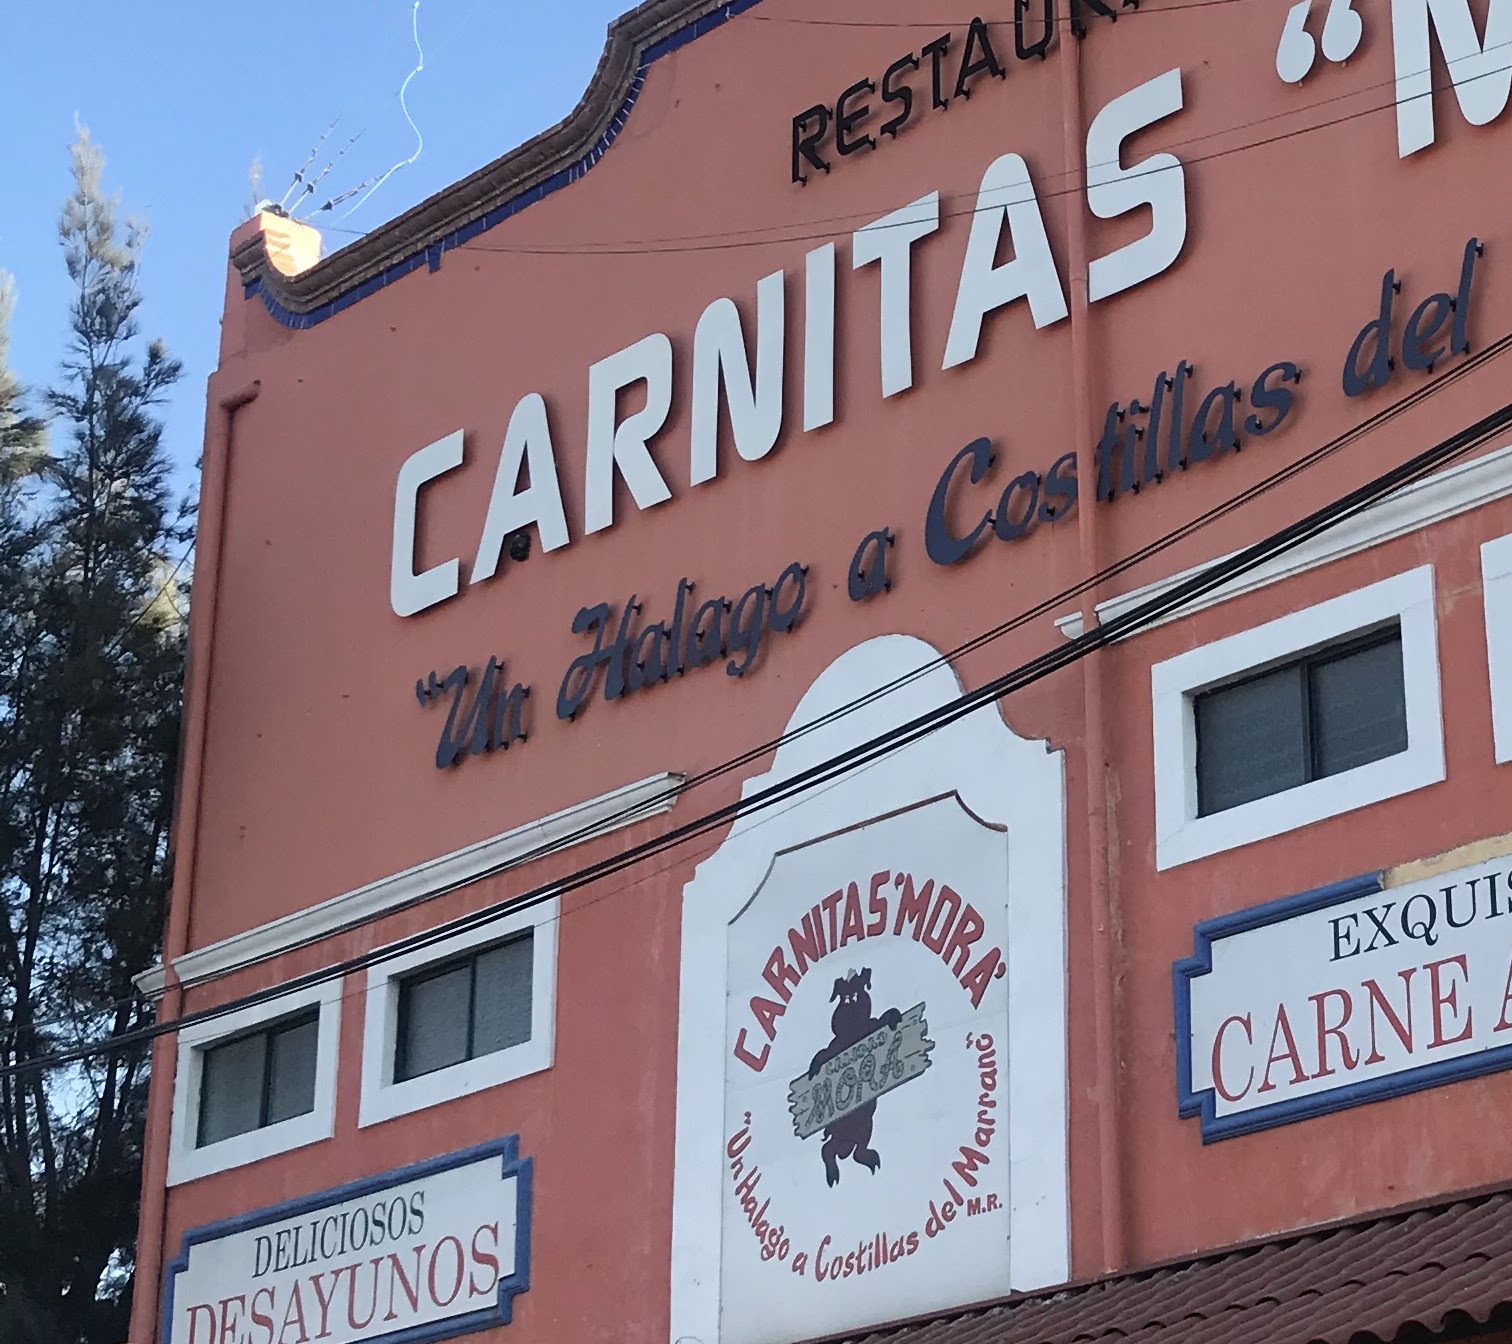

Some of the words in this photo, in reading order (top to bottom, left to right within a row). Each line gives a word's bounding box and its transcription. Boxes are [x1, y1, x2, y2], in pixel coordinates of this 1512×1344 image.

[390, 67, 1188, 618] CARNITAS
[556, 560, 809, 720] Halago
[848, 525, 898, 603] a
[925, 359, 1306, 566] Costillas
[1342, 237, 1478, 397] del
[733, 869, 891, 1073] CARNITAS
[1211, 953, 1473, 1102] CARNE
[804, 1030, 905, 1128] MORA
[252, 1190, 426, 1279] DELICIOSOS
[735, 1166, 790, 1262] Halago
[792, 1251, 809, 1276] a
[814, 1230, 920, 1283] Costillas
[925, 1177, 965, 1239] del
[966, 1192, 1003, 1217] M.R.
